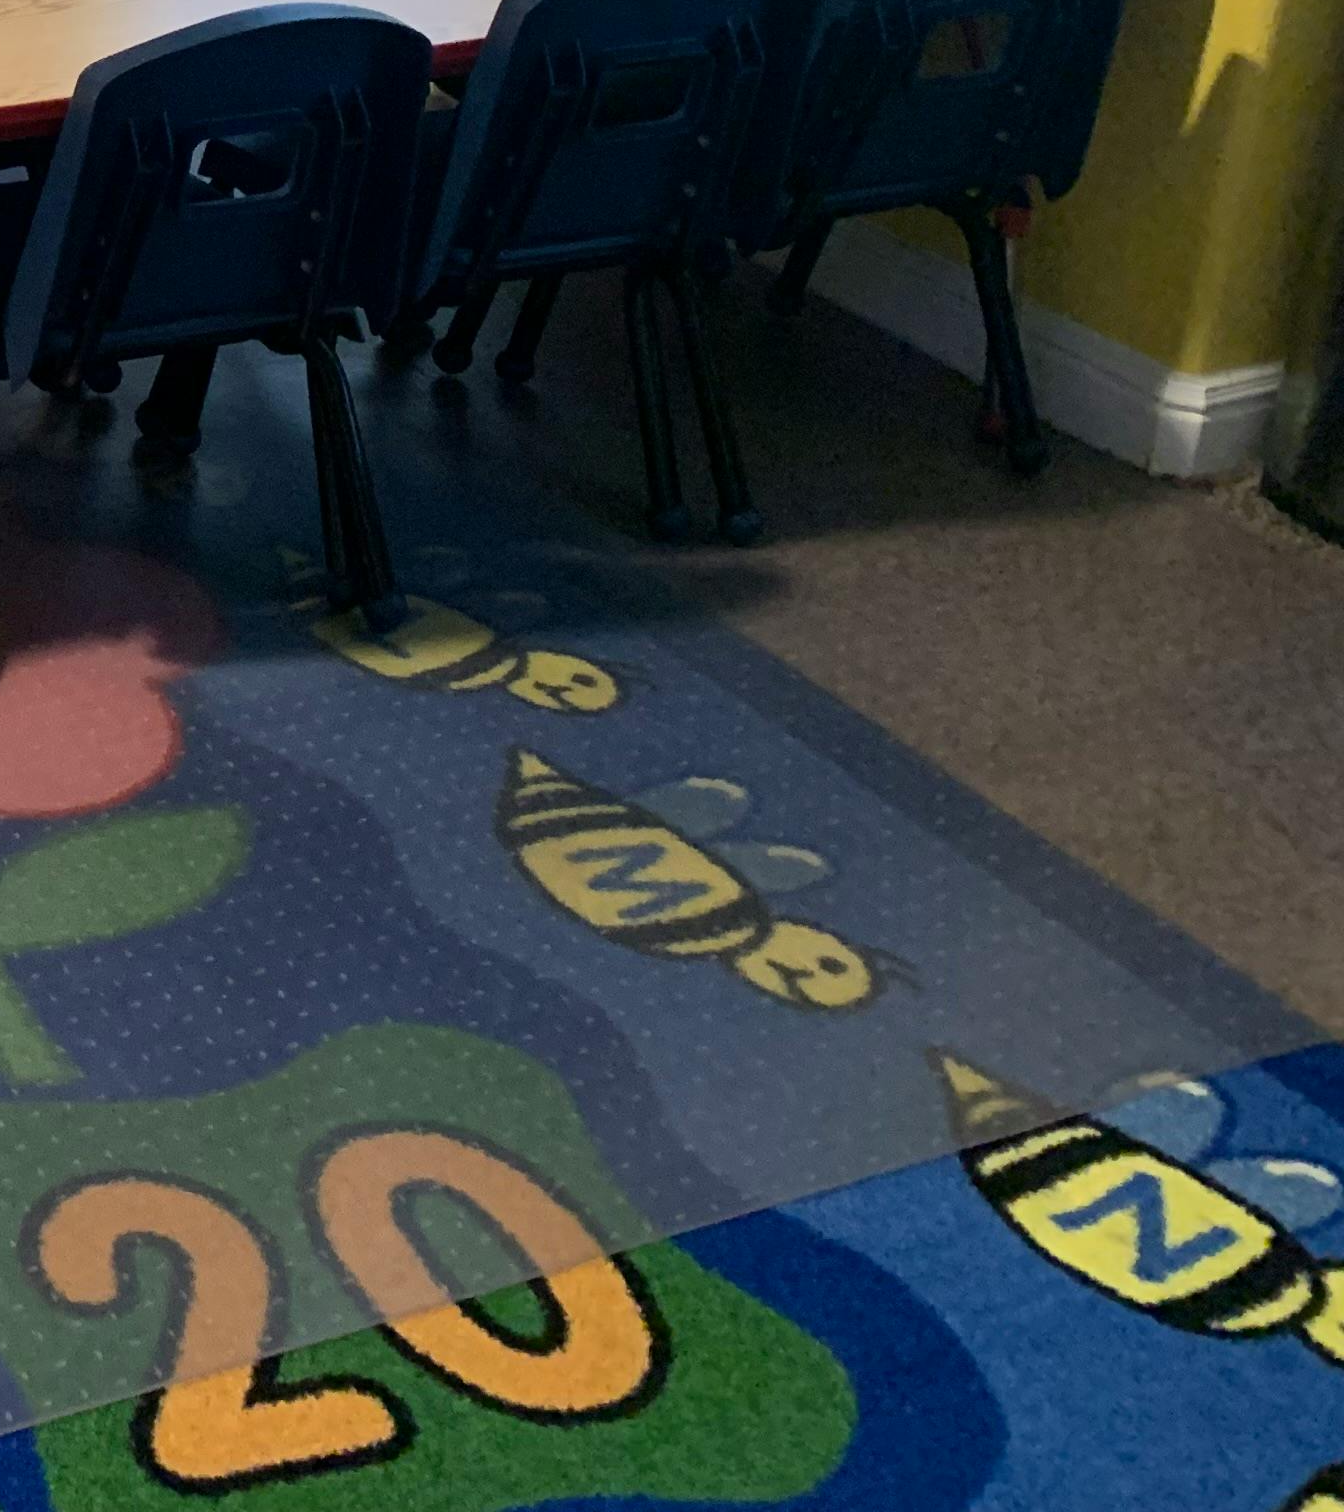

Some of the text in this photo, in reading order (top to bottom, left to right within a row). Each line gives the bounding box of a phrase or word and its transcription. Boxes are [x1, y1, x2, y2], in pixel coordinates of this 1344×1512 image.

[565, 842, 712, 919] M
[1048, 1171, 1242, 1284] N
[20, 1118, 673, 1494] 20
